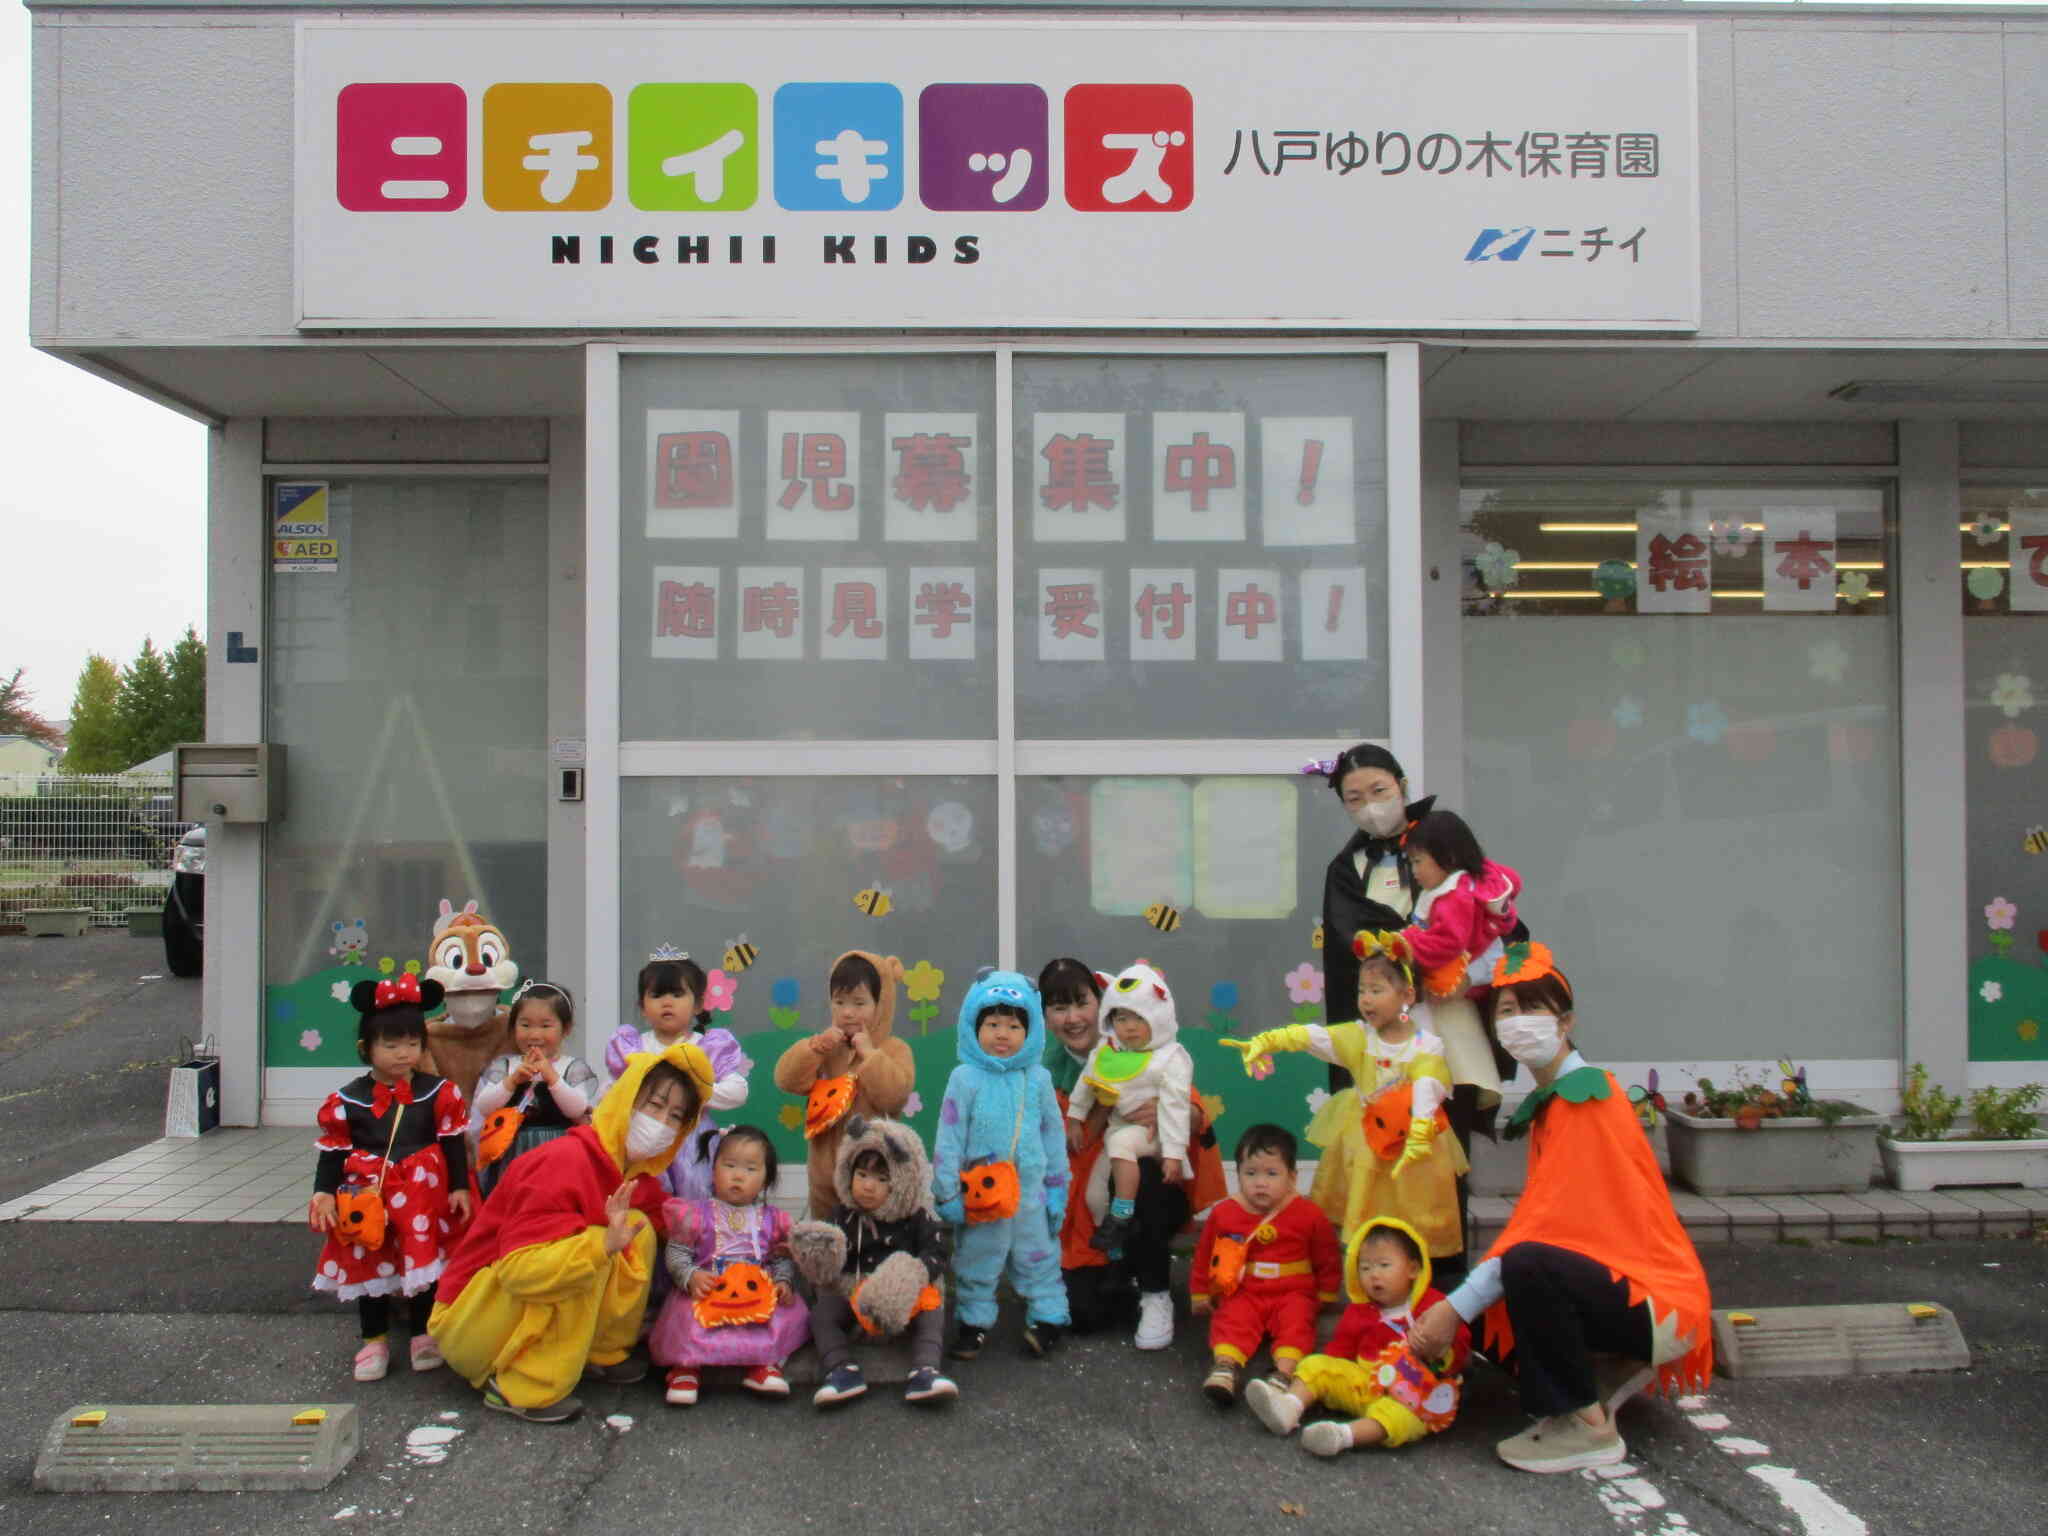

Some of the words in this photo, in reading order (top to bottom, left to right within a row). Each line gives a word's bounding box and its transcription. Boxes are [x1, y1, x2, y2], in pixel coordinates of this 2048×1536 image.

[379, 129, 1186, 204] ニチイキッズ
[1223, 130, 1660, 179] 八戸ゆりの木保育園
[551, 235, 777, 264] NICHII
[823, 235, 981, 264] KIDS
[1540, 226, 1648, 264] ニチイ
[295, 542, 333, 555] AED
